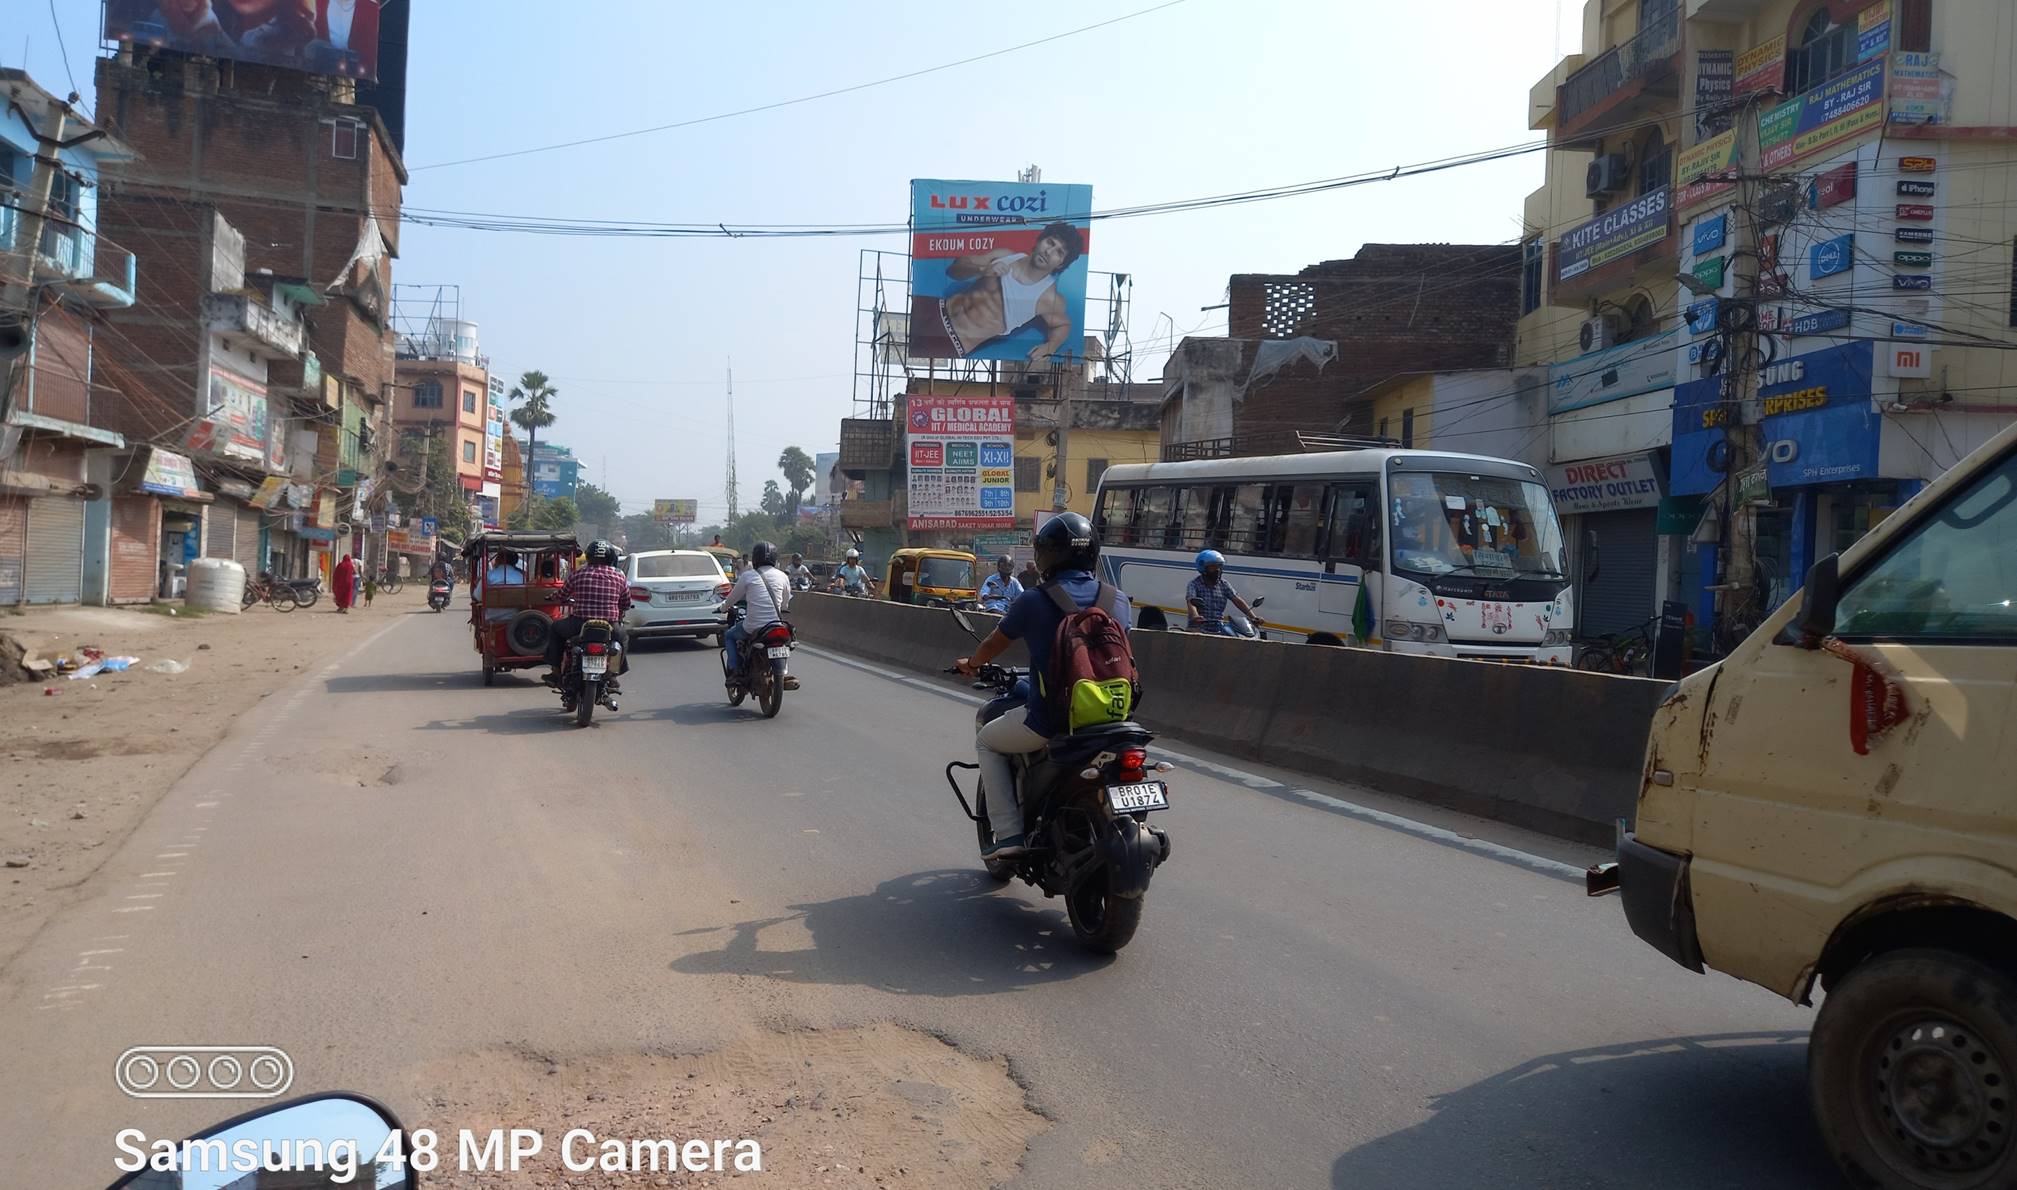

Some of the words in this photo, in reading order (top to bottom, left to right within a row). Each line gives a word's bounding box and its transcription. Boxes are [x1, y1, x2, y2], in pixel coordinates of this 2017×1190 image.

[1905, 54, 1928, 67] RAJ
[1700, 78, 1731, 92] Physics
[1808, 93, 1823, 105] RAJ
[1825, 64, 1881, 96] MATHEMATICS
[1824, 98, 1834, 110] BY
[1840, 88, 1856, 103] RAJ
[1858, 81, 1871, 95] SIR
[1760, 103, 1799, 127] CHEMISTRY
[1769, 144, 1792, 166] OTHERS
[1908, 184, 1933, 194] iPhone
[930, 195, 992, 209] LUX
[997, 190, 1047, 212] cozi
[960, 215, 1017, 223] UNDERWEAR
[1572, 223, 1601, 249] KITE
[1604, 191, 1665, 235] CLASSES
[1697, 229, 1719, 243] vivo
[969, 238, 995, 250] COZY
[1821, 251, 1838, 263] DELL
[1795, 318, 1818, 333] HDB
[912, 399, 922, 407] 13
[1764, 386, 1827, 415] RPRISES
[931, 407, 1012, 422] GLOBAL
[931, 422, 941, 432] IIT
[947, 422, 977, 432] MEDICAL
[979, 422, 1012, 432] ACADEMY
[915, 450, 939, 459] IIT-JEE
[1565, 460, 1628, 485] DIRECT
[1803, 467, 1818, 478] SPH
[1819, 464, 1861, 476] Enterprises
[1553, 485, 1604, 503] FACTORY
[1606, 478, 1656, 497] OUTLET
[984, 499, 993, 507] 9th
[997, 499, 1010, 507] 10th
[912, 520, 957, 529] ANISABAD
[1295, 581, 1316, 591] Starbus
[1485, 590, 1511, 599] TATA
[1118, 784, 1157, 797] BR01E
[1121, 794, 1160, 807] U1874
